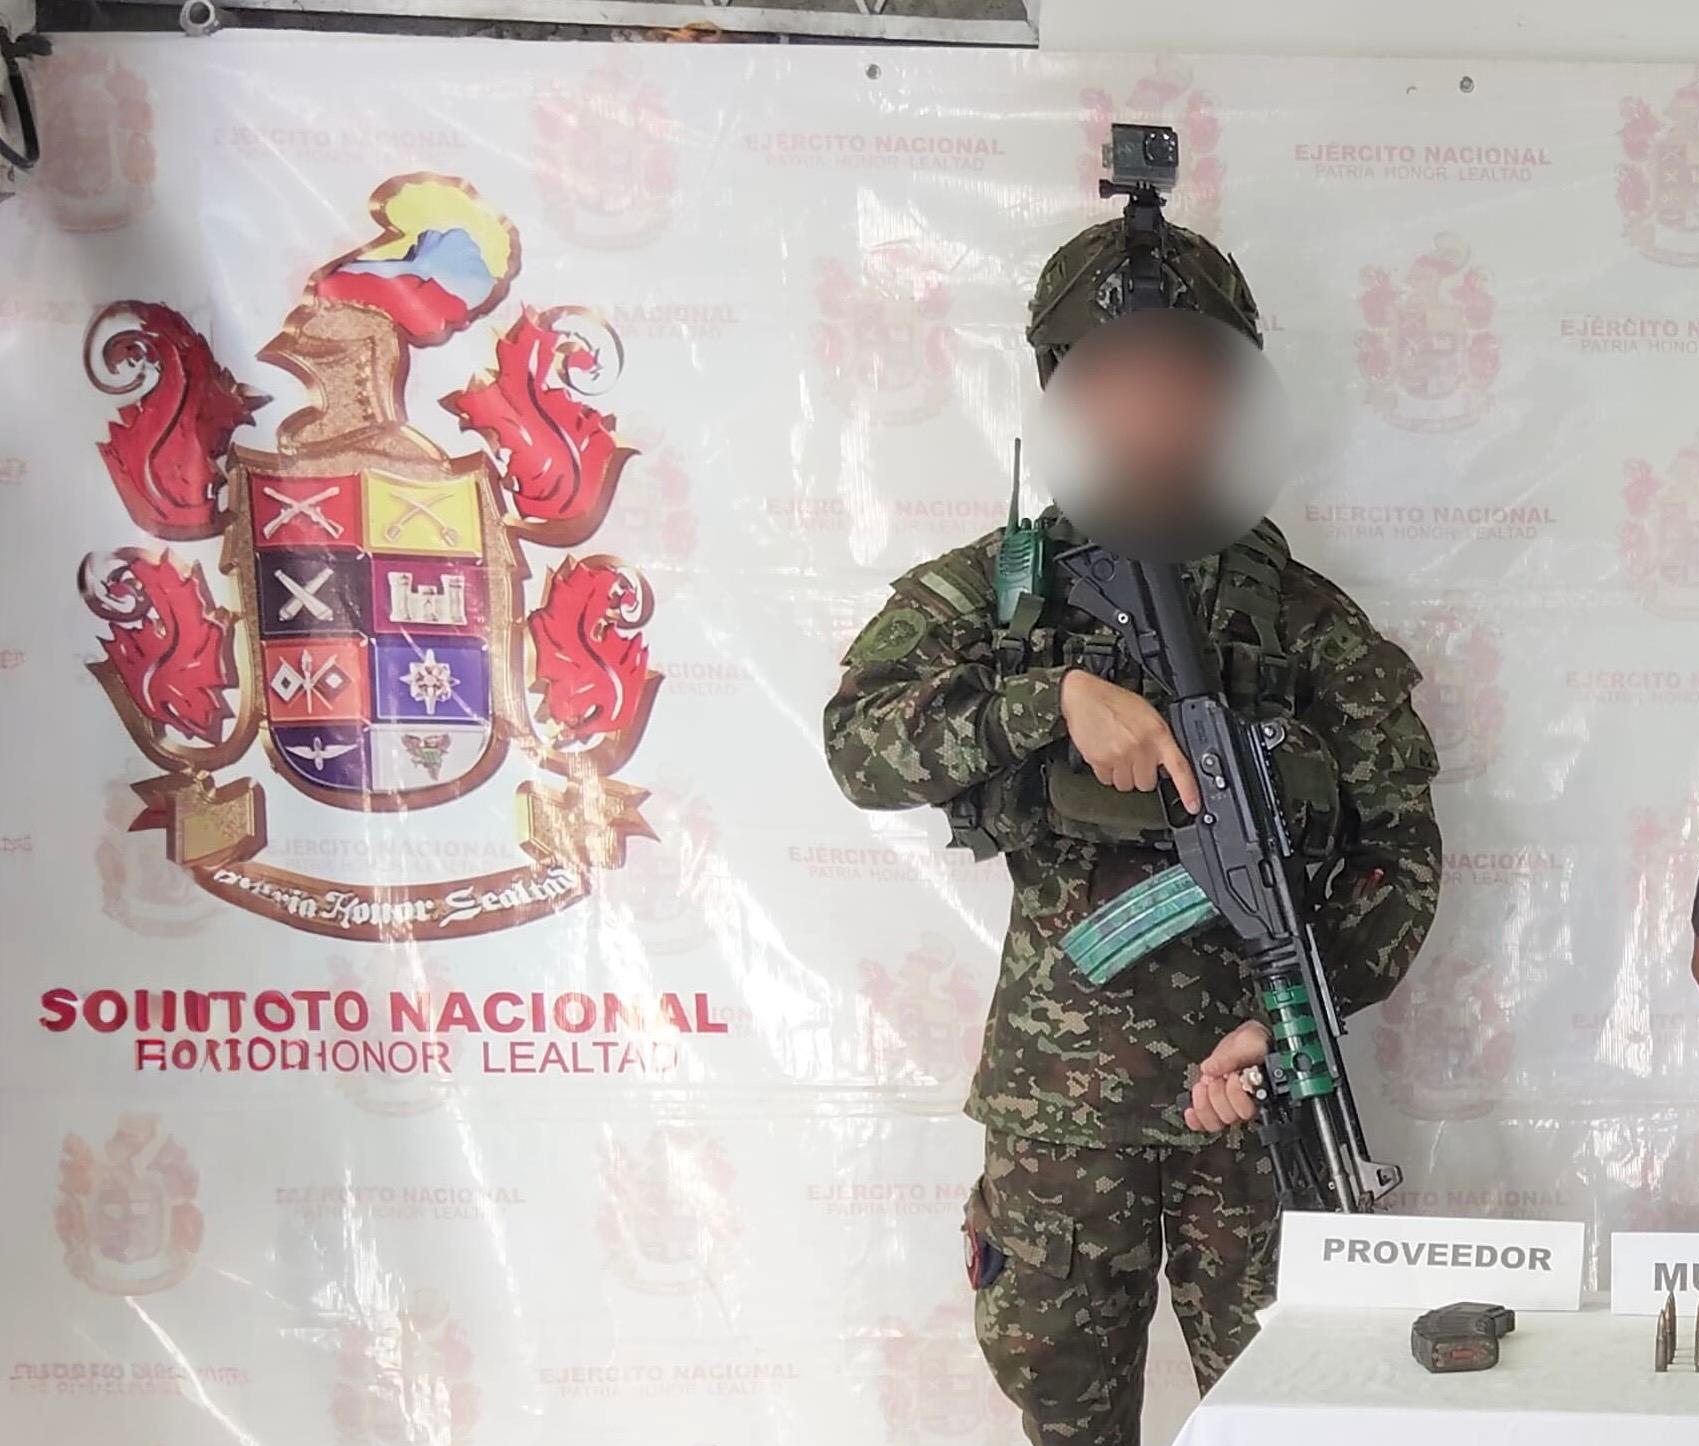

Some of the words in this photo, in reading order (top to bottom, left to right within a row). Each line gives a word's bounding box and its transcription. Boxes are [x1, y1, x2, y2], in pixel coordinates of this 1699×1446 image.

[874, 134, 1006, 156] NACIONAL
[910, 155, 985, 171] LEALTAD
[1424, 145, 1552, 166] NACIONAL
[1315, 165, 1375, 179] PATRIA
[1384, 166, 1447, 181] HONOR
[1459, 167, 1533, 182] LEALTAD
[1580, 338, 1639, 353] PATRIA
[1433, 505, 1558, 525] NACIONAL
[1327, 525, 1385, 540] PATRIA
[808, 866, 863, 880] PATRIA
[389, 991, 729, 1034] NACIONAL
[403, 1187, 527, 1204] NACIOAL
[1322, 1237, 1553, 1272] PROVEEDOR
[672, 1361, 801, 1382] NACIONAL
